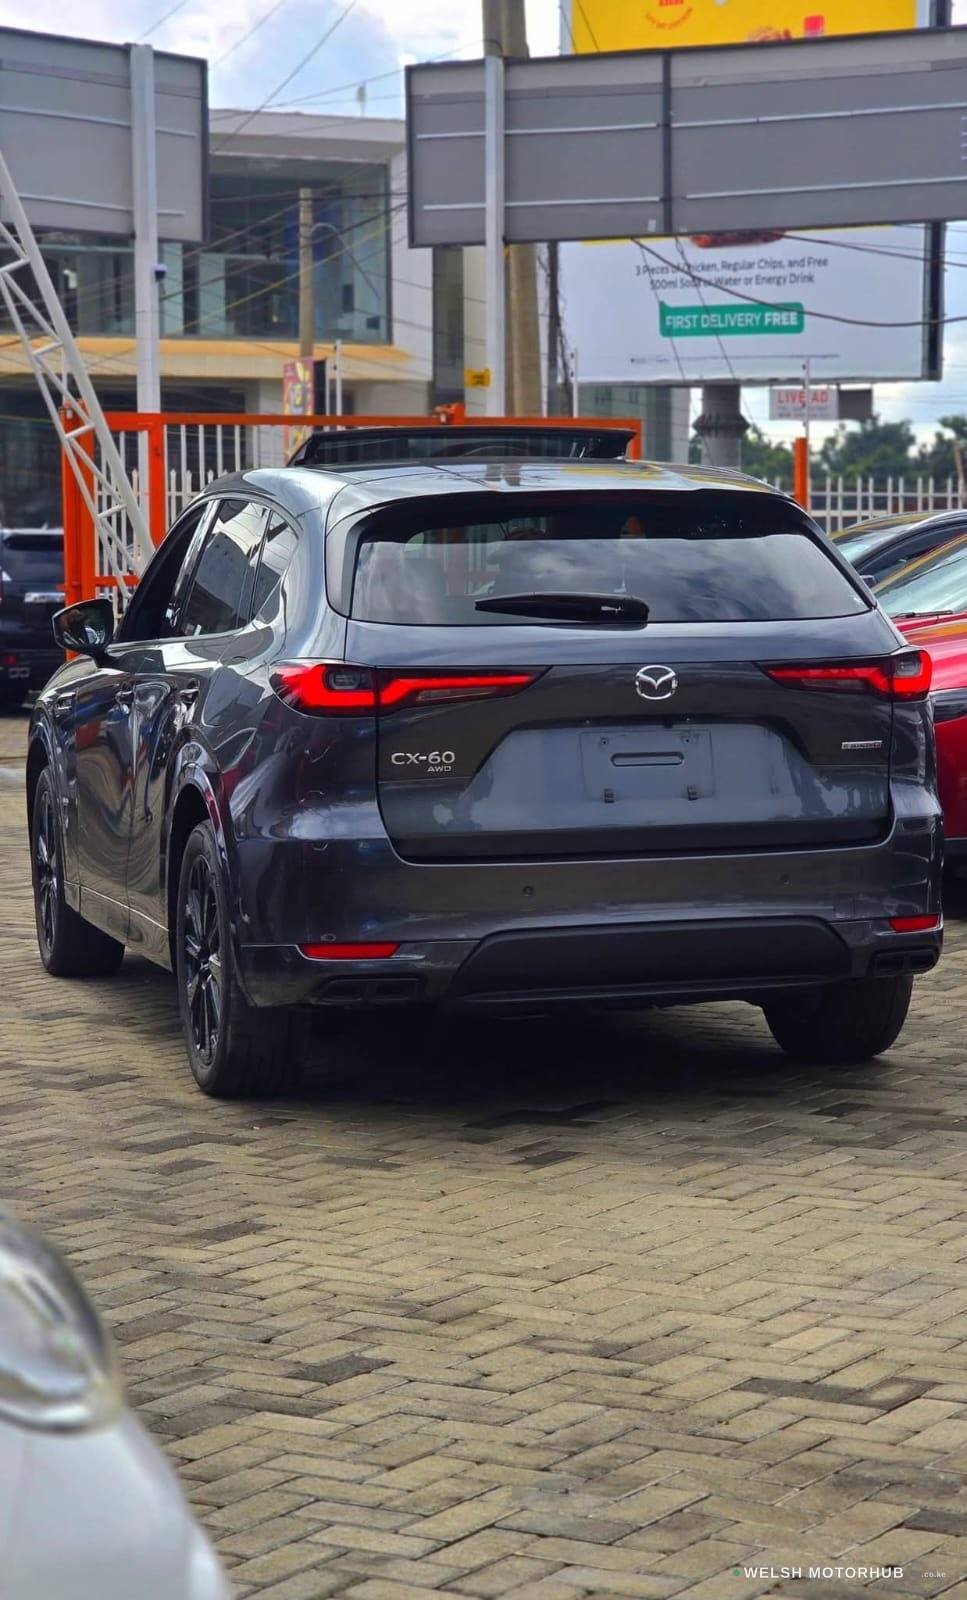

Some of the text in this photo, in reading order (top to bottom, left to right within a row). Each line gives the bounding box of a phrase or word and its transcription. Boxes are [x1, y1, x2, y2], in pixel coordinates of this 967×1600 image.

[635, 266, 641, 276] 3
[642, 264, 669, 276] Pieces
[721, 259, 756, 273] Regular
[787, 256, 805, 268] and
[807, 256, 829, 268] Free
[714, 274, 742, 286] Water
[744, 276, 753, 286] or
[755, 273, 787, 287] Energy
[789, 272, 815, 284] Drink
[665, 311, 798, 329] FIRST DELIVERY FREE
[777, 391, 829, 404] LIVE AD
[391, 751, 456, 765] CX-60
